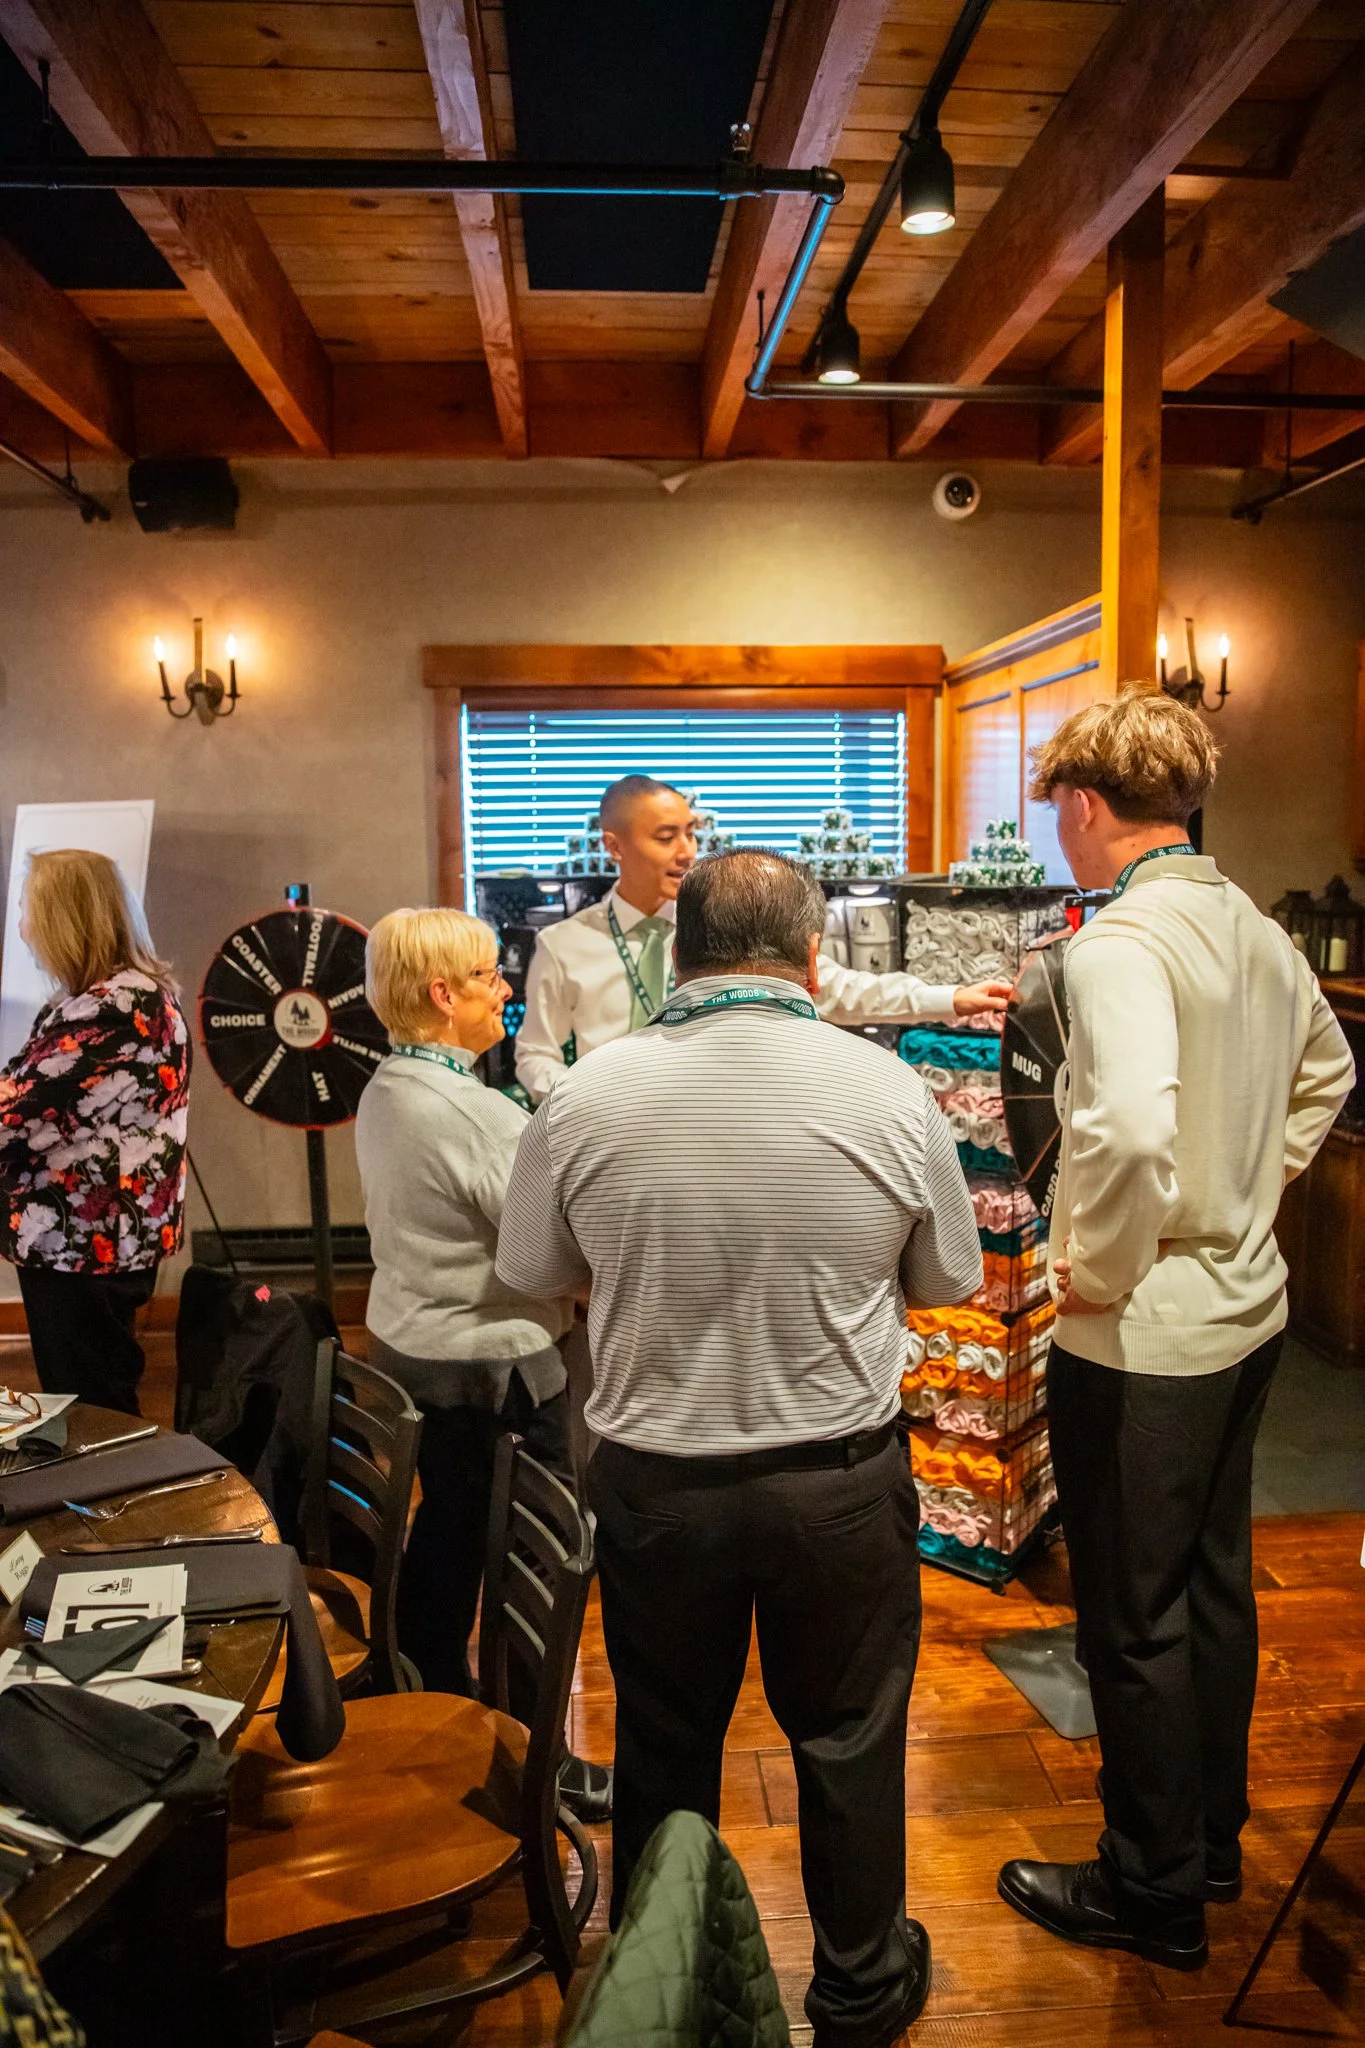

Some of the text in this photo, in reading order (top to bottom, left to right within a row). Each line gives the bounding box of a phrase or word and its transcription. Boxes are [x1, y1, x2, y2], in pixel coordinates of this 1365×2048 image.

[232, 936, 283, 995] COASTER
[302, 913, 324, 987] FOOTBALL
[711, 989, 760, 1004] THE WOODS
[210, 1014, 267, 1027] CHOICE
[244, 1044, 287, 1105] ORNAMENT
[1012, 1052, 1042, 1083] MUG
[312, 1071, 331, 1102] HAT
